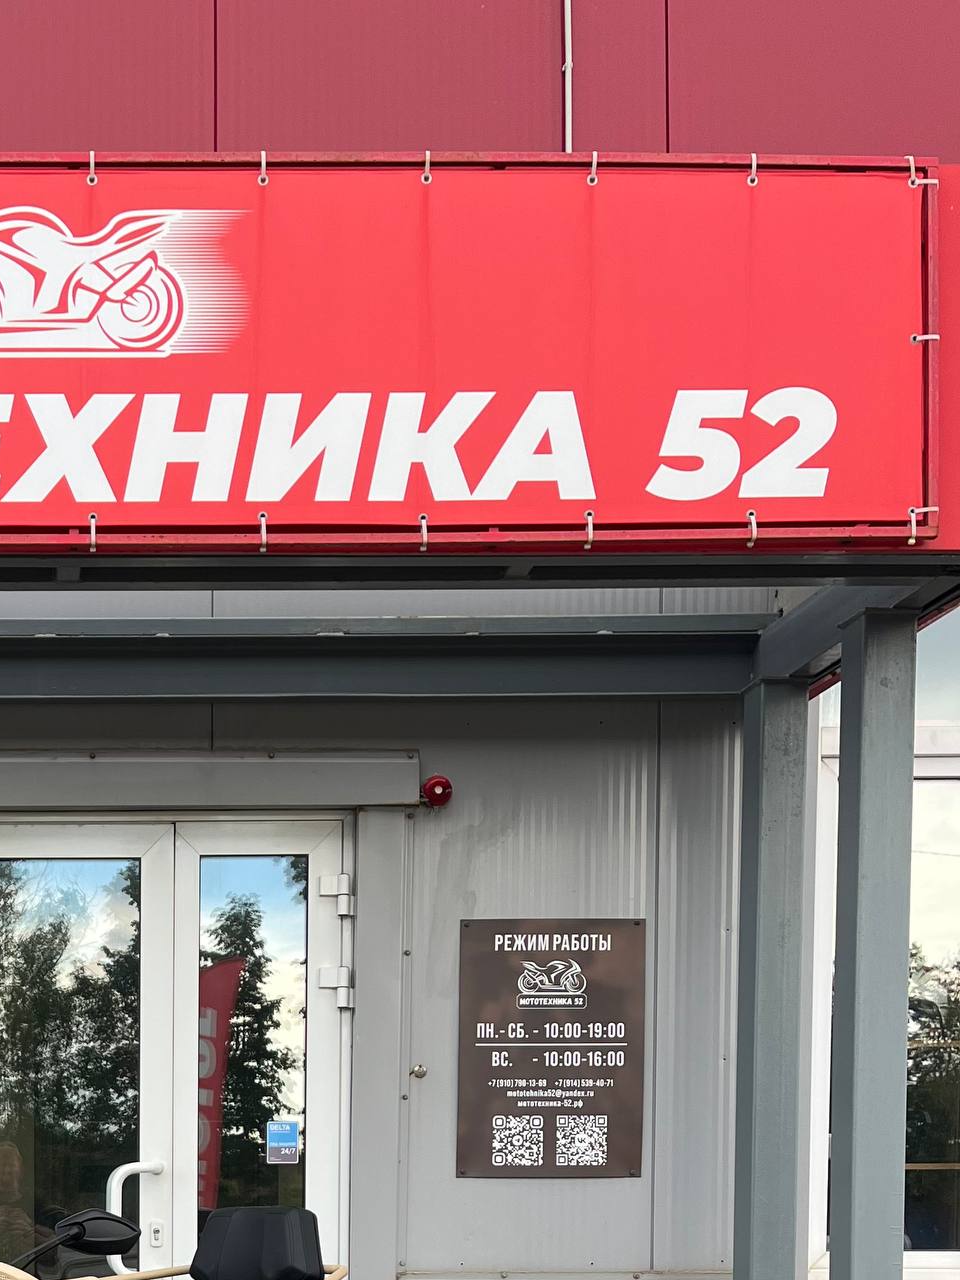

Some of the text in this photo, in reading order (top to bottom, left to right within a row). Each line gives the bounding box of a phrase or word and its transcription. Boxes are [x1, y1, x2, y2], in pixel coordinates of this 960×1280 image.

[645, 387, 838, 500] 52
[494, 934, 612, 951] РЕЖИМ РАБОТЫ
[519, 997, 584, 1005] МОТОТЕХНИКА 52
[544, 1022, 625, 1039] 10:00-19:00
[491, 1051, 513, 1067] ВС.
[543, 1051, 625, 1067] 10:00-16:00
